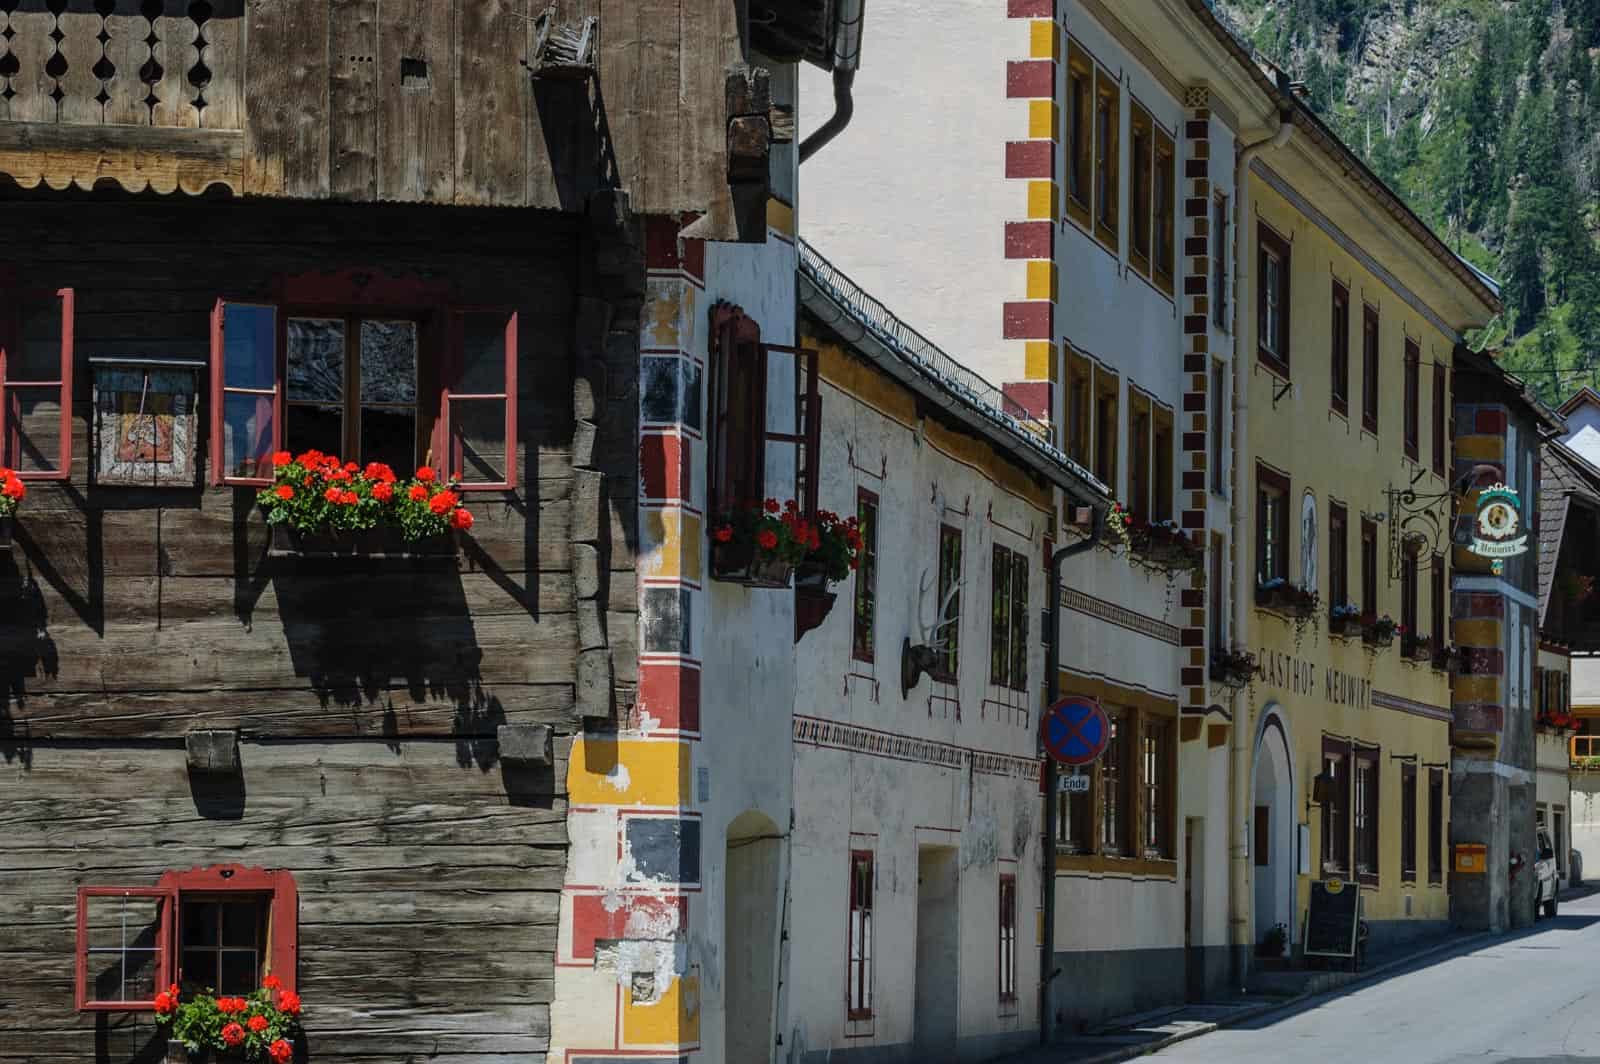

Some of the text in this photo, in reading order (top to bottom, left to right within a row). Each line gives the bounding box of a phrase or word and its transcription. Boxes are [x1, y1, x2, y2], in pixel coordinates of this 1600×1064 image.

[1259, 648, 1370, 711] GASTHOF NEUWIRT
[1063, 777, 1087, 789] Ende
